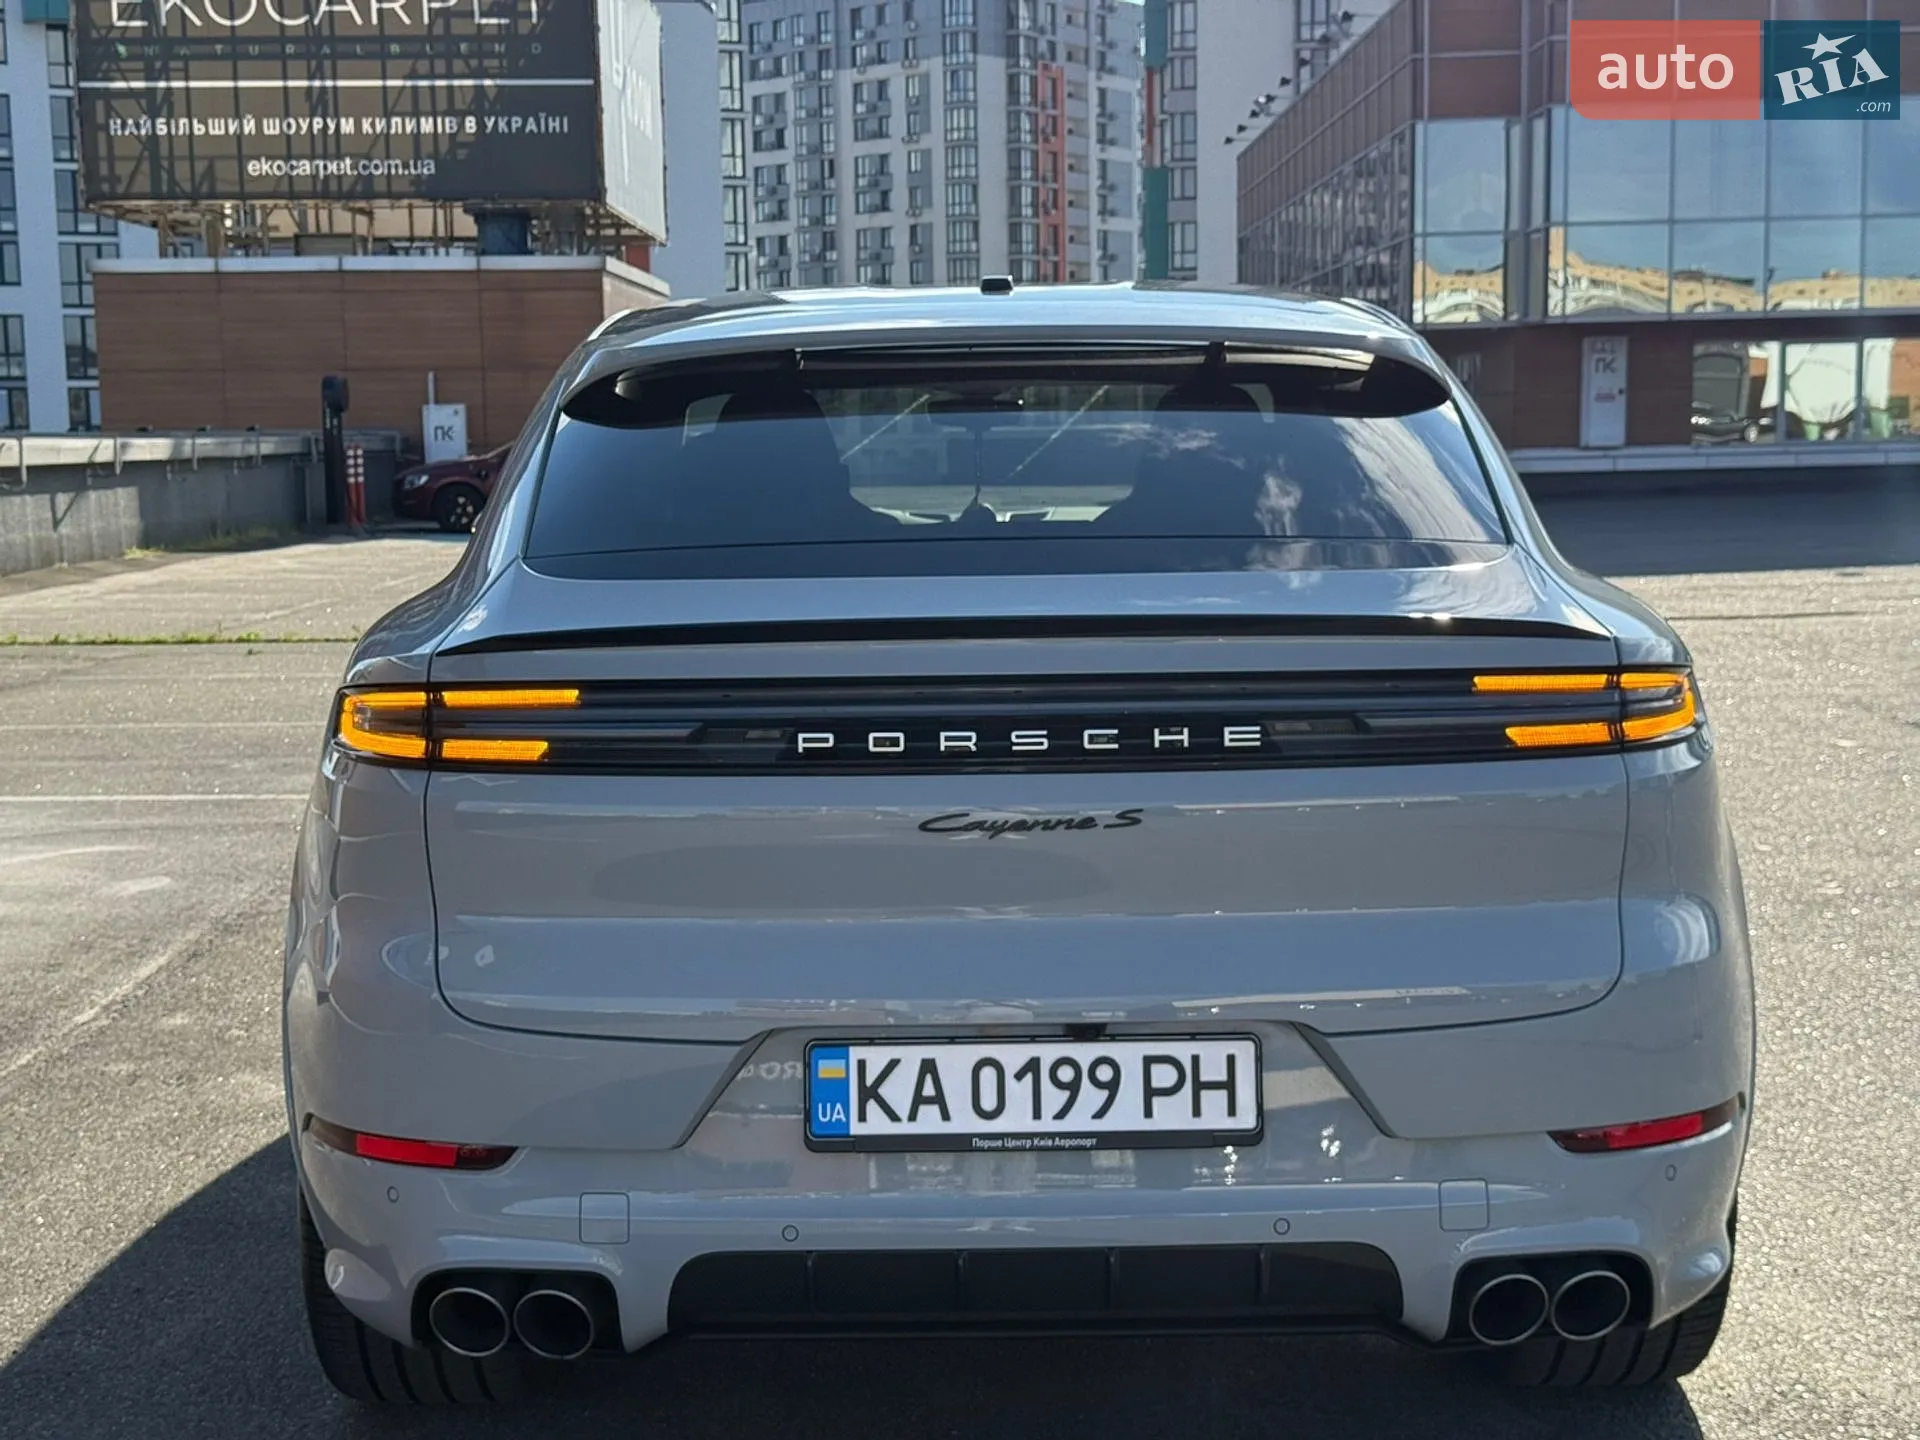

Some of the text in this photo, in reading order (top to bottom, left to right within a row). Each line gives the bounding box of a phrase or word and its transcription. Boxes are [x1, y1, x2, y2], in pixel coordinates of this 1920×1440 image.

[109, 112, 568, 136] НАЙБІЛЬШИЙ ШОУРУМ КИЛИМІВ В УКРАЇНІ
[247, 156, 436, 179] ekocarpet.com.ua
[798, 726, 1262, 752] PORSCHE
[918, 808, 1144, 840] Cayenne S
[856, 1053, 1237, 1123] KA 0199 PH
[818, 1102, 846, 1123] UA
[972, 1137, 1002, 1149] Порше
[1004, 1136, 1032, 1148] Центр
[1054, 1136, 1097, 1148] Аеропорт
